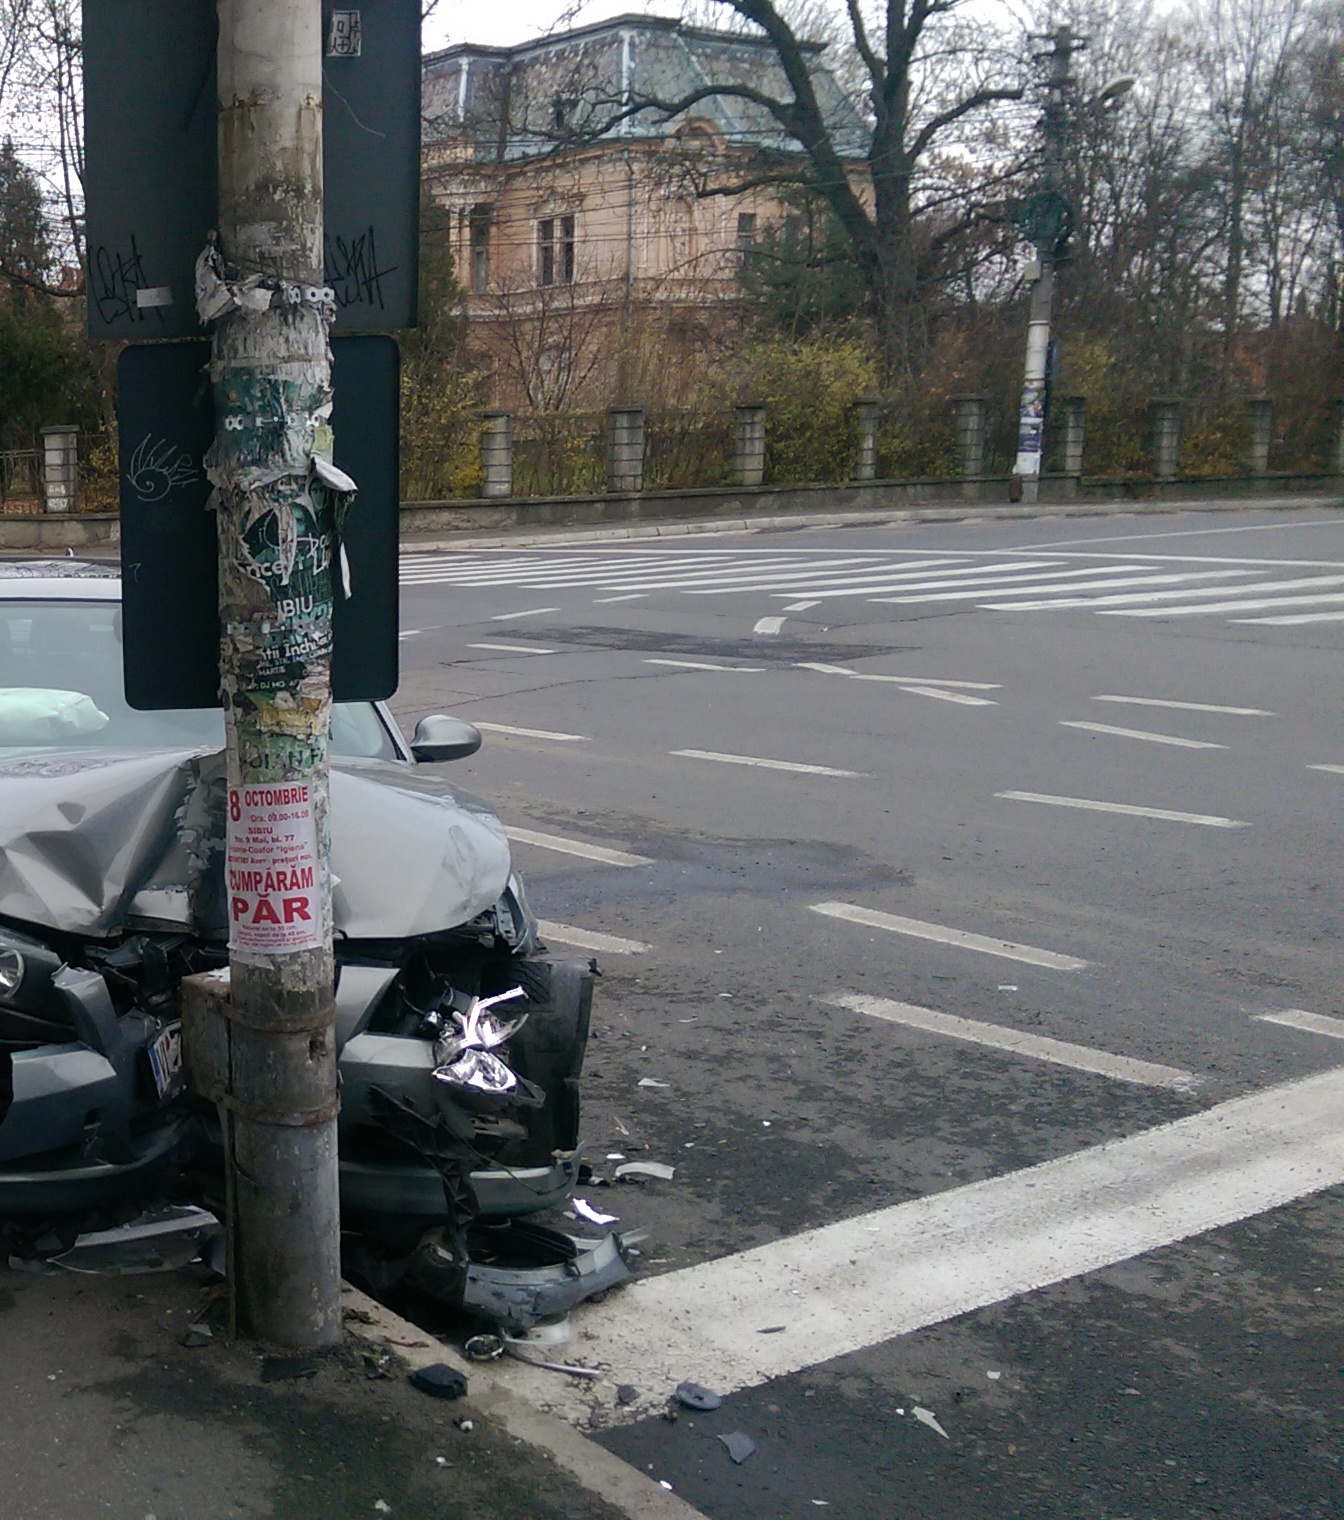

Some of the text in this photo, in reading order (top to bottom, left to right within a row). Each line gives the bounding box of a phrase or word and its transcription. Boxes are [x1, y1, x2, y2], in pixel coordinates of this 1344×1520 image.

[276, 594, 313, 617] IBIU
[244, 786, 308, 807] OCTOMBRIE
[247, 826, 273, 835] SIBIU
[284, 834, 295, 843] 77
[229, 863, 314, 892] CUMPĂRĂM
[232, 892, 312, 924] PĂR
